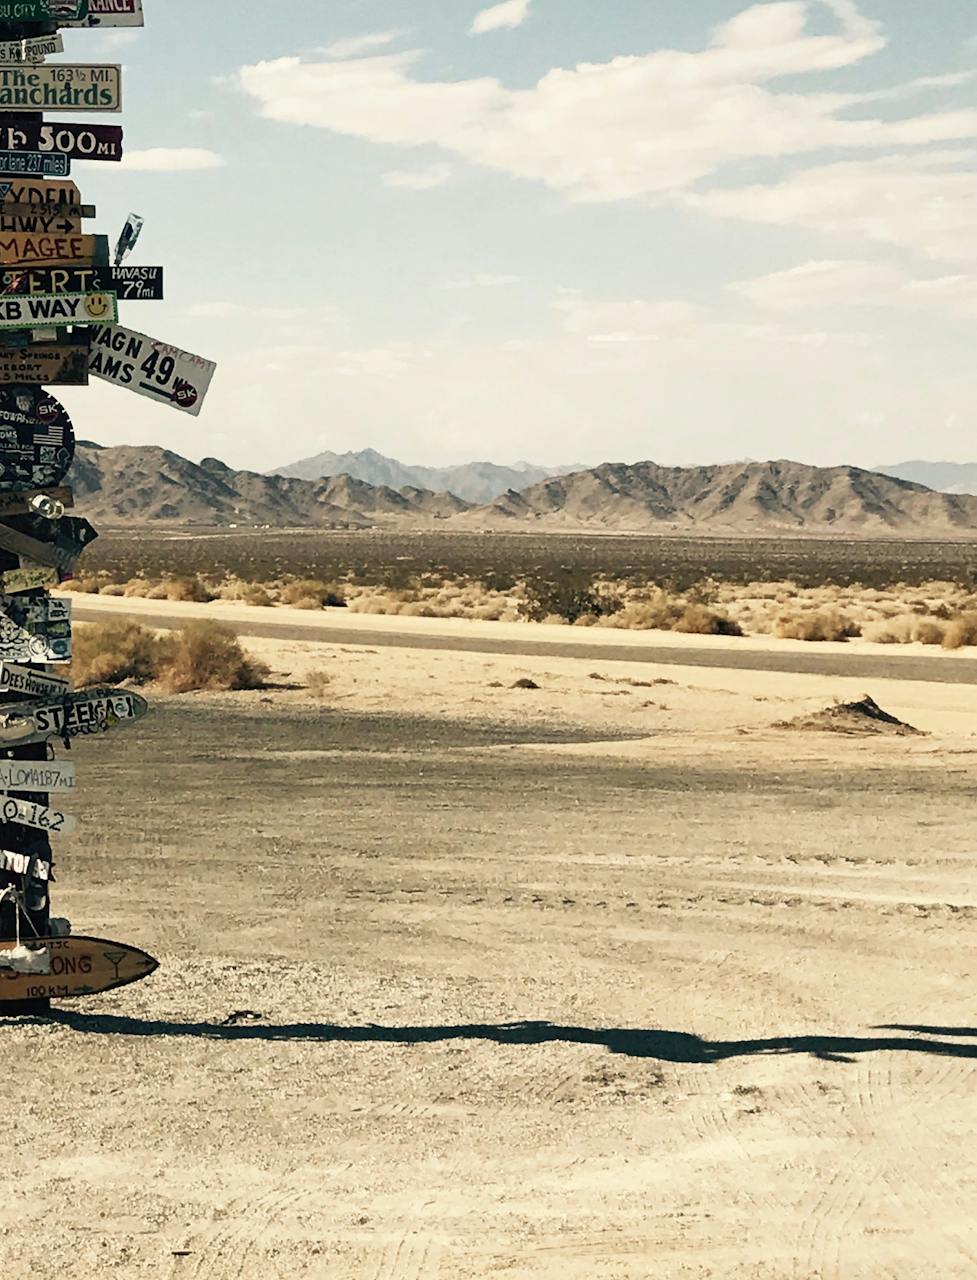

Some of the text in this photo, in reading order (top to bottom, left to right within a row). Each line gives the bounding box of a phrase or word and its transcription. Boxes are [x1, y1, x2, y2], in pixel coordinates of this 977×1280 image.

[0, 70, 40, 88] The
[38, 126, 96, 154] 500
[97, 142, 116, 156] MI
[44, 156, 65, 174] miles
[0, 216, 55, 233] HWY
[112, 268, 157, 280] HAVASU
[29, 298, 81, 318] WAY
[140, 350, 176, 386] 49
[176, 389, 196, 400] SK
[38, 404, 58, 414] SK
[26, 986, 46, 997] 100
